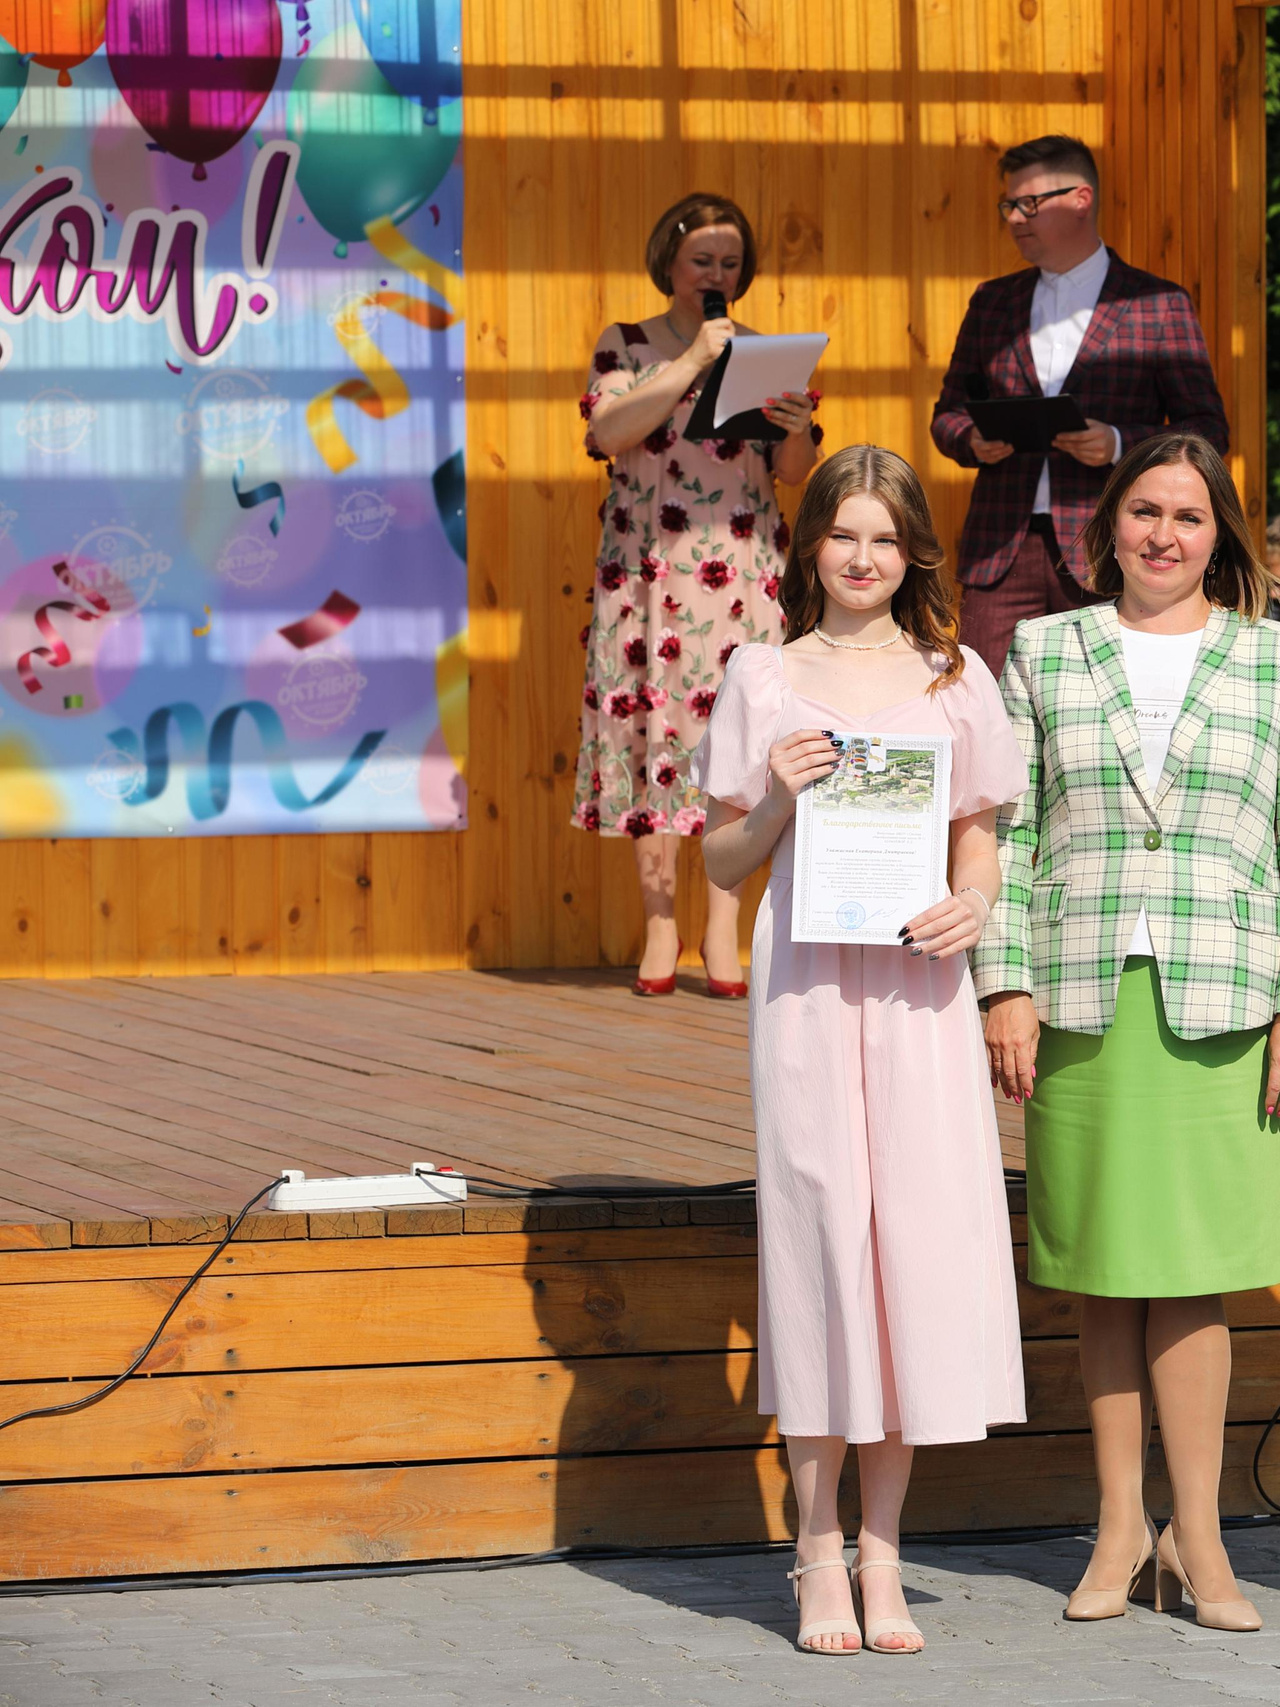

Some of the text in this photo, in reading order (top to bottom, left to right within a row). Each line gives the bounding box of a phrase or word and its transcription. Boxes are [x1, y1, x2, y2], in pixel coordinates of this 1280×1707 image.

[16, 406, 98, 437] ОКТЯБРЬ
[175, 396, 291, 436] ОКТЯБРЬ
[334, 503, 397, 527] ОКТЯБРЬ
[216, 547, 279, 573] ОКТЯБРЬ
[277, 673, 368, 705] ОКТЯБРЬ
